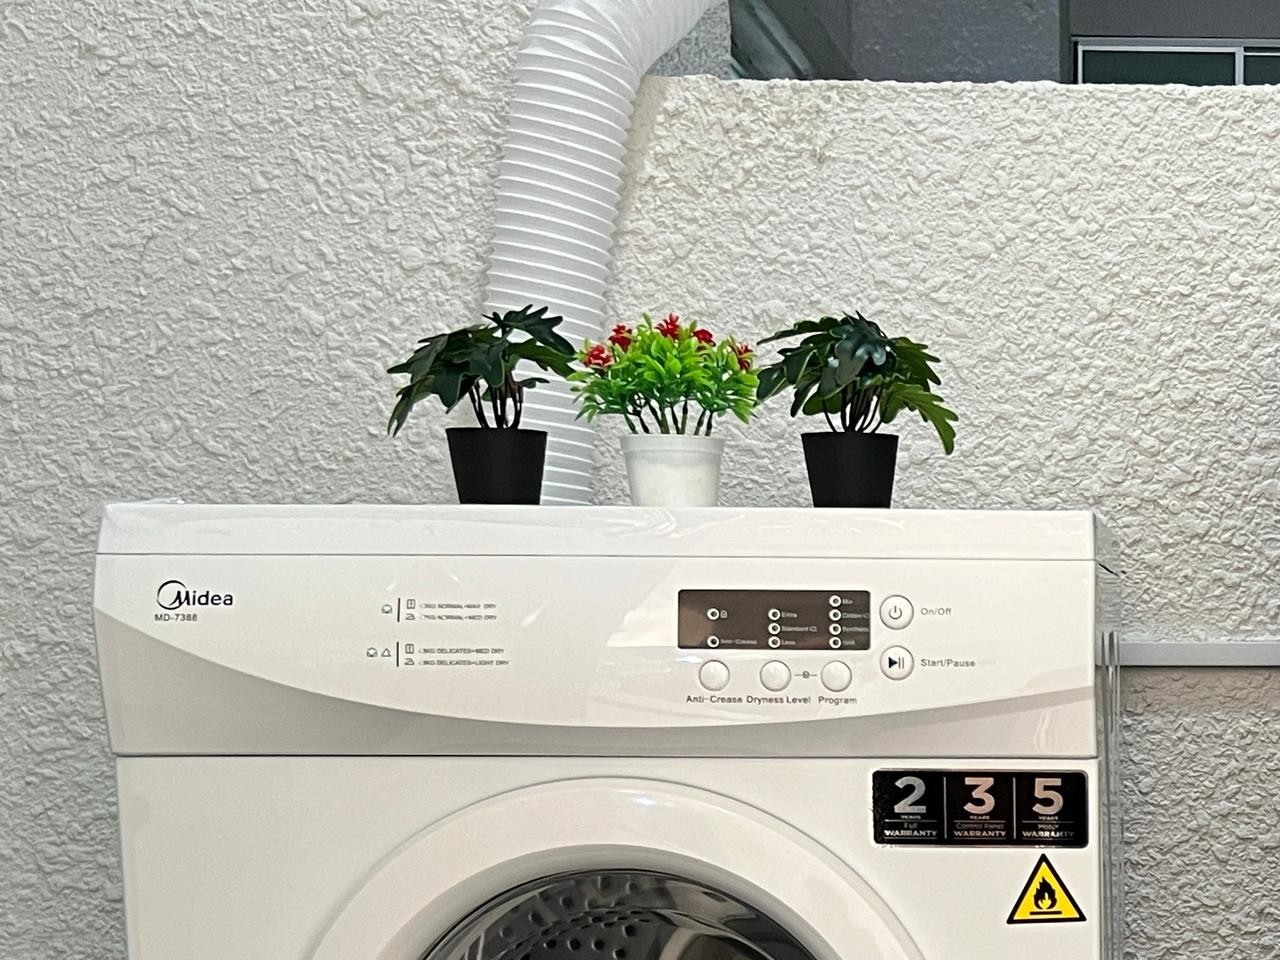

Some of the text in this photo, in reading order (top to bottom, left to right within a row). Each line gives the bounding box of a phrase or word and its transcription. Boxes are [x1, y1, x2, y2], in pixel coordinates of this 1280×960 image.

[156, 579, 234, 611] Midea
[920, 607, 952, 617] On/Off
[154, 613, 198, 622] MD-7388
[920, 658, 976, 669] Start/Pause
[686, 695, 743, 704] Anti-Crease
[746, 696, 811, 705] Dryness Level
[818, 696, 857, 706] Program
[894, 776, 926, 813] 2
[963, 777, 995, 814] 3
[1032, 778, 1064, 815] 5
